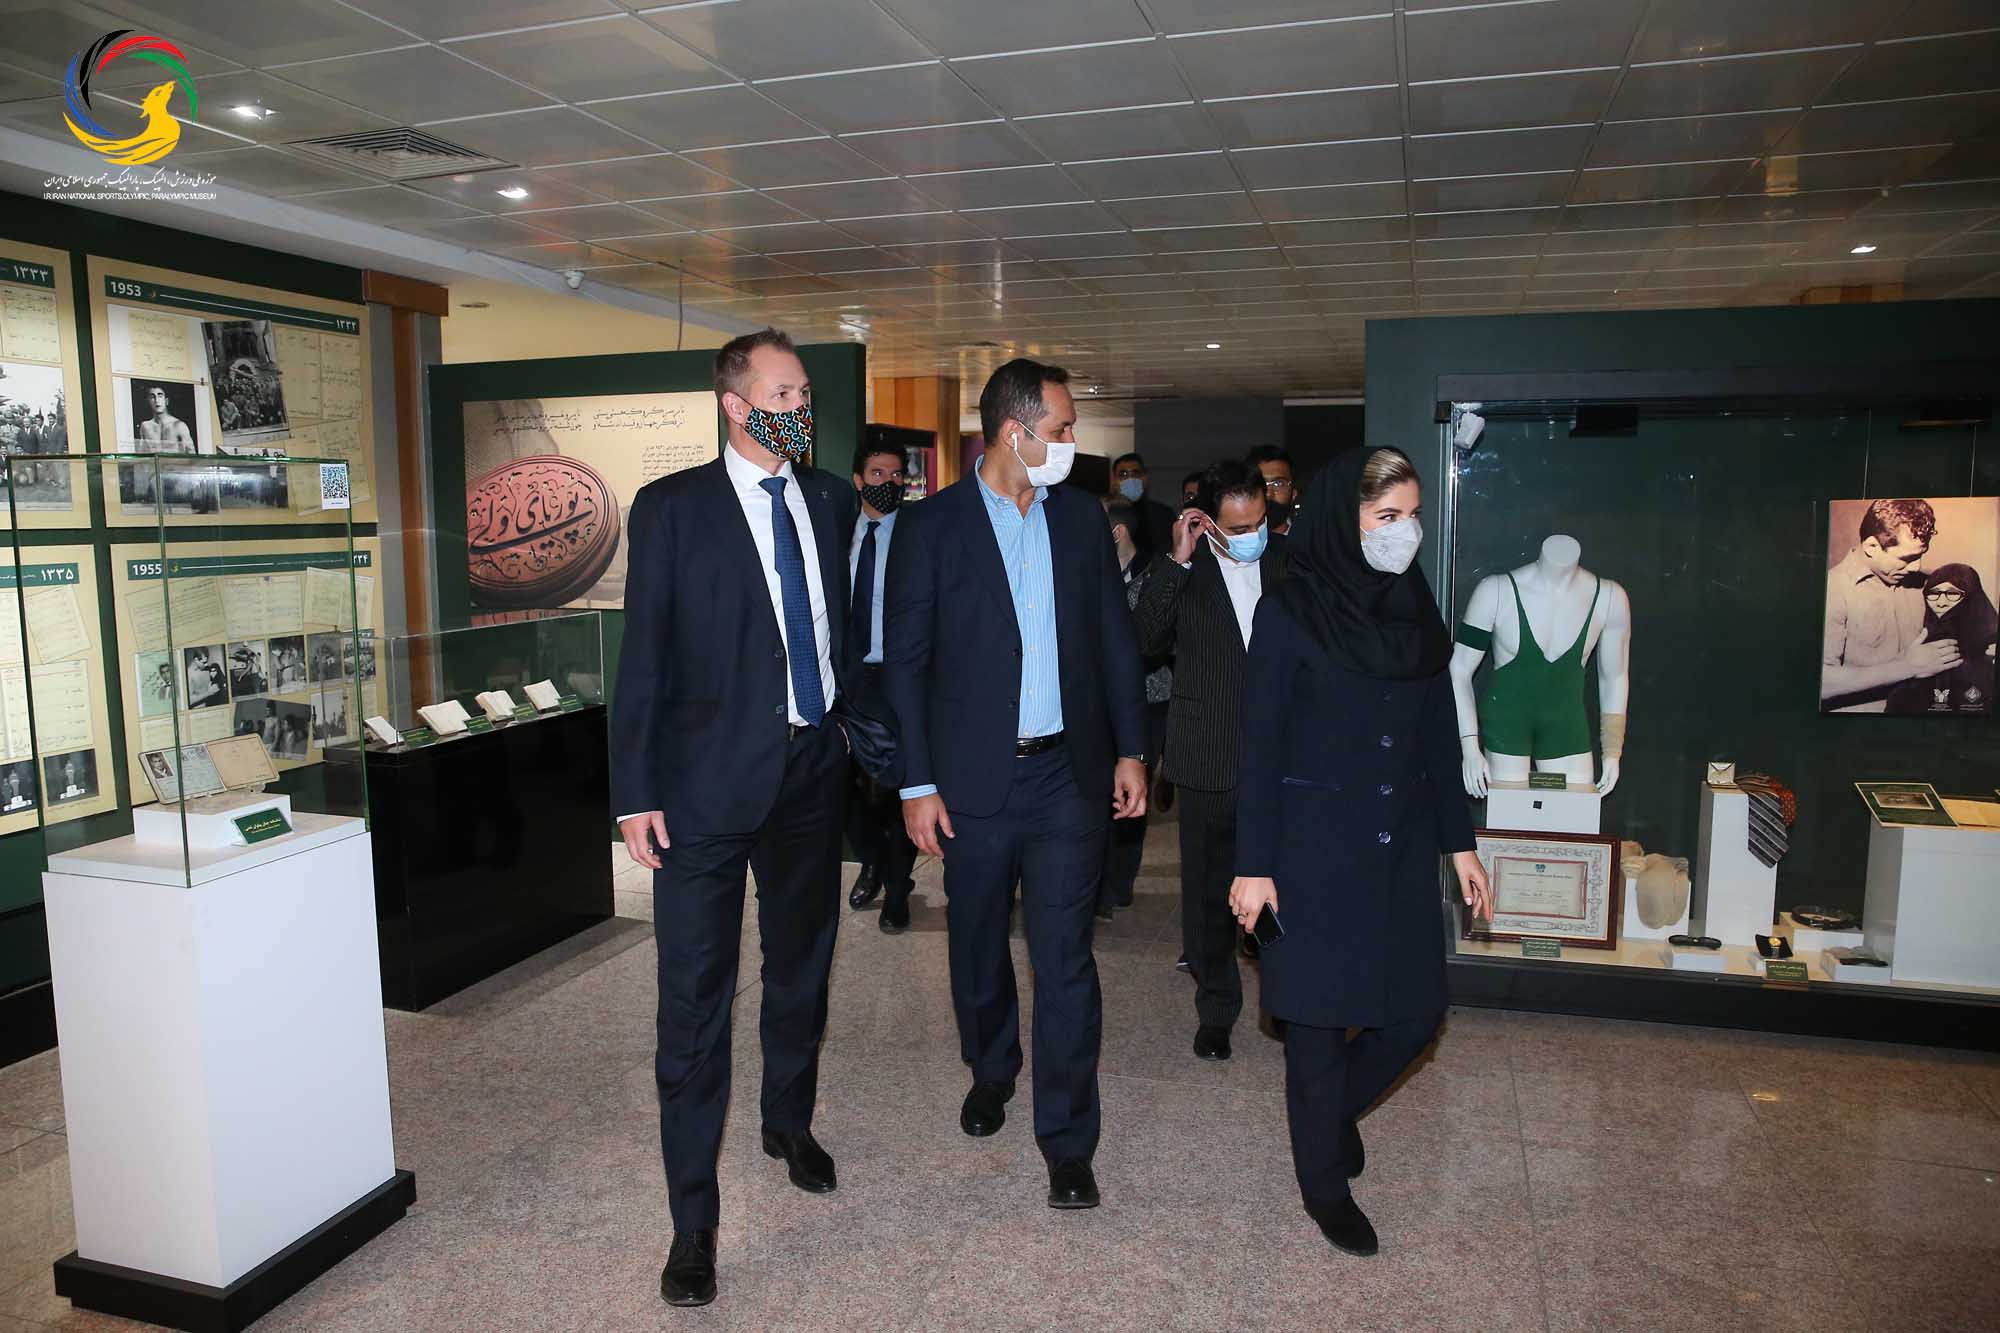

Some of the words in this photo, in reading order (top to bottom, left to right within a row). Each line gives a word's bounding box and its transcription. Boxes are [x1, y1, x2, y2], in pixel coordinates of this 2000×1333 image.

[13, 265, 48, 282] ۱۳۳۳
[110, 281, 142, 297] 1953
[41, 567, 74, 582] ۱۳۳۵
[132, 563, 162, 576] 1955
